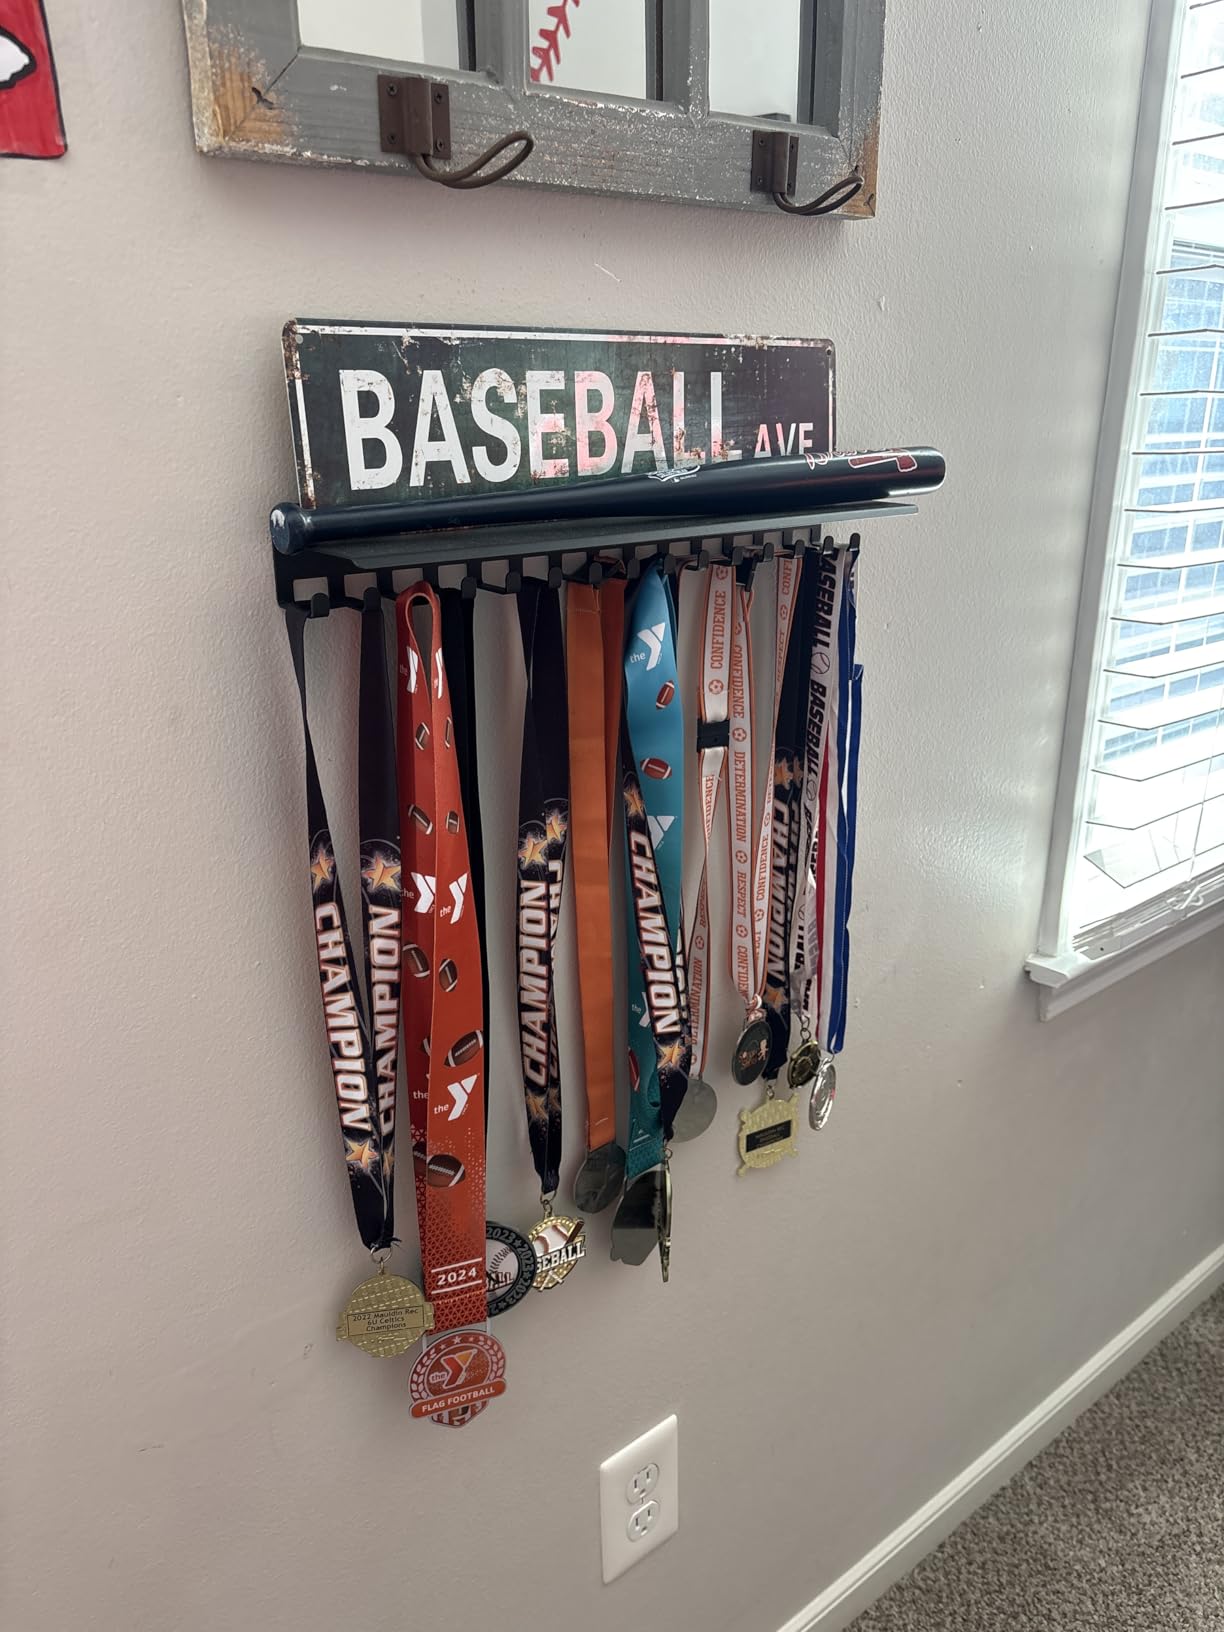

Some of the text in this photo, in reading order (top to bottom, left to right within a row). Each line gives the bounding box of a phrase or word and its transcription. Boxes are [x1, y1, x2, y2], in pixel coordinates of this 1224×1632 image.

[339, 367, 814, 491] BASEBALL AVE
[711, 590, 726, 669] CONFIDENCE
[630, 652, 646, 663] the
[732, 644, 745, 719] CONFIDENCE
[803, 680, 827, 785] BASEBALL
[734, 752, 746, 842] DETERMINATION
[756, 833, 769, 902] CONFIDENCE
[767, 800, 790, 982] CHAMPION
[440, 905, 451, 917] the
[736, 871, 747, 918] RESPECT
[630, 830, 682, 1035] CHAMPION
[520, 879, 548, 1088] CHAMPION
[315, 901, 372, 1132] CHAMPION
[368, 904, 400, 1137] CHAMPION
[433, 1104, 449, 1115] the
[437, 1267, 477, 1285] 2024
[519, 1244, 535, 1272] 2023
[505, 1277, 531, 1302] 2023
[366, 1322, 407, 1332] Champions
[374, 1310, 402, 1319] Mauldin
[380, 1316, 405, 1324] Celtics
[421, 1386, 495, 1412] FLAG FOOTBALL
[431, 1372, 446, 1381] the
